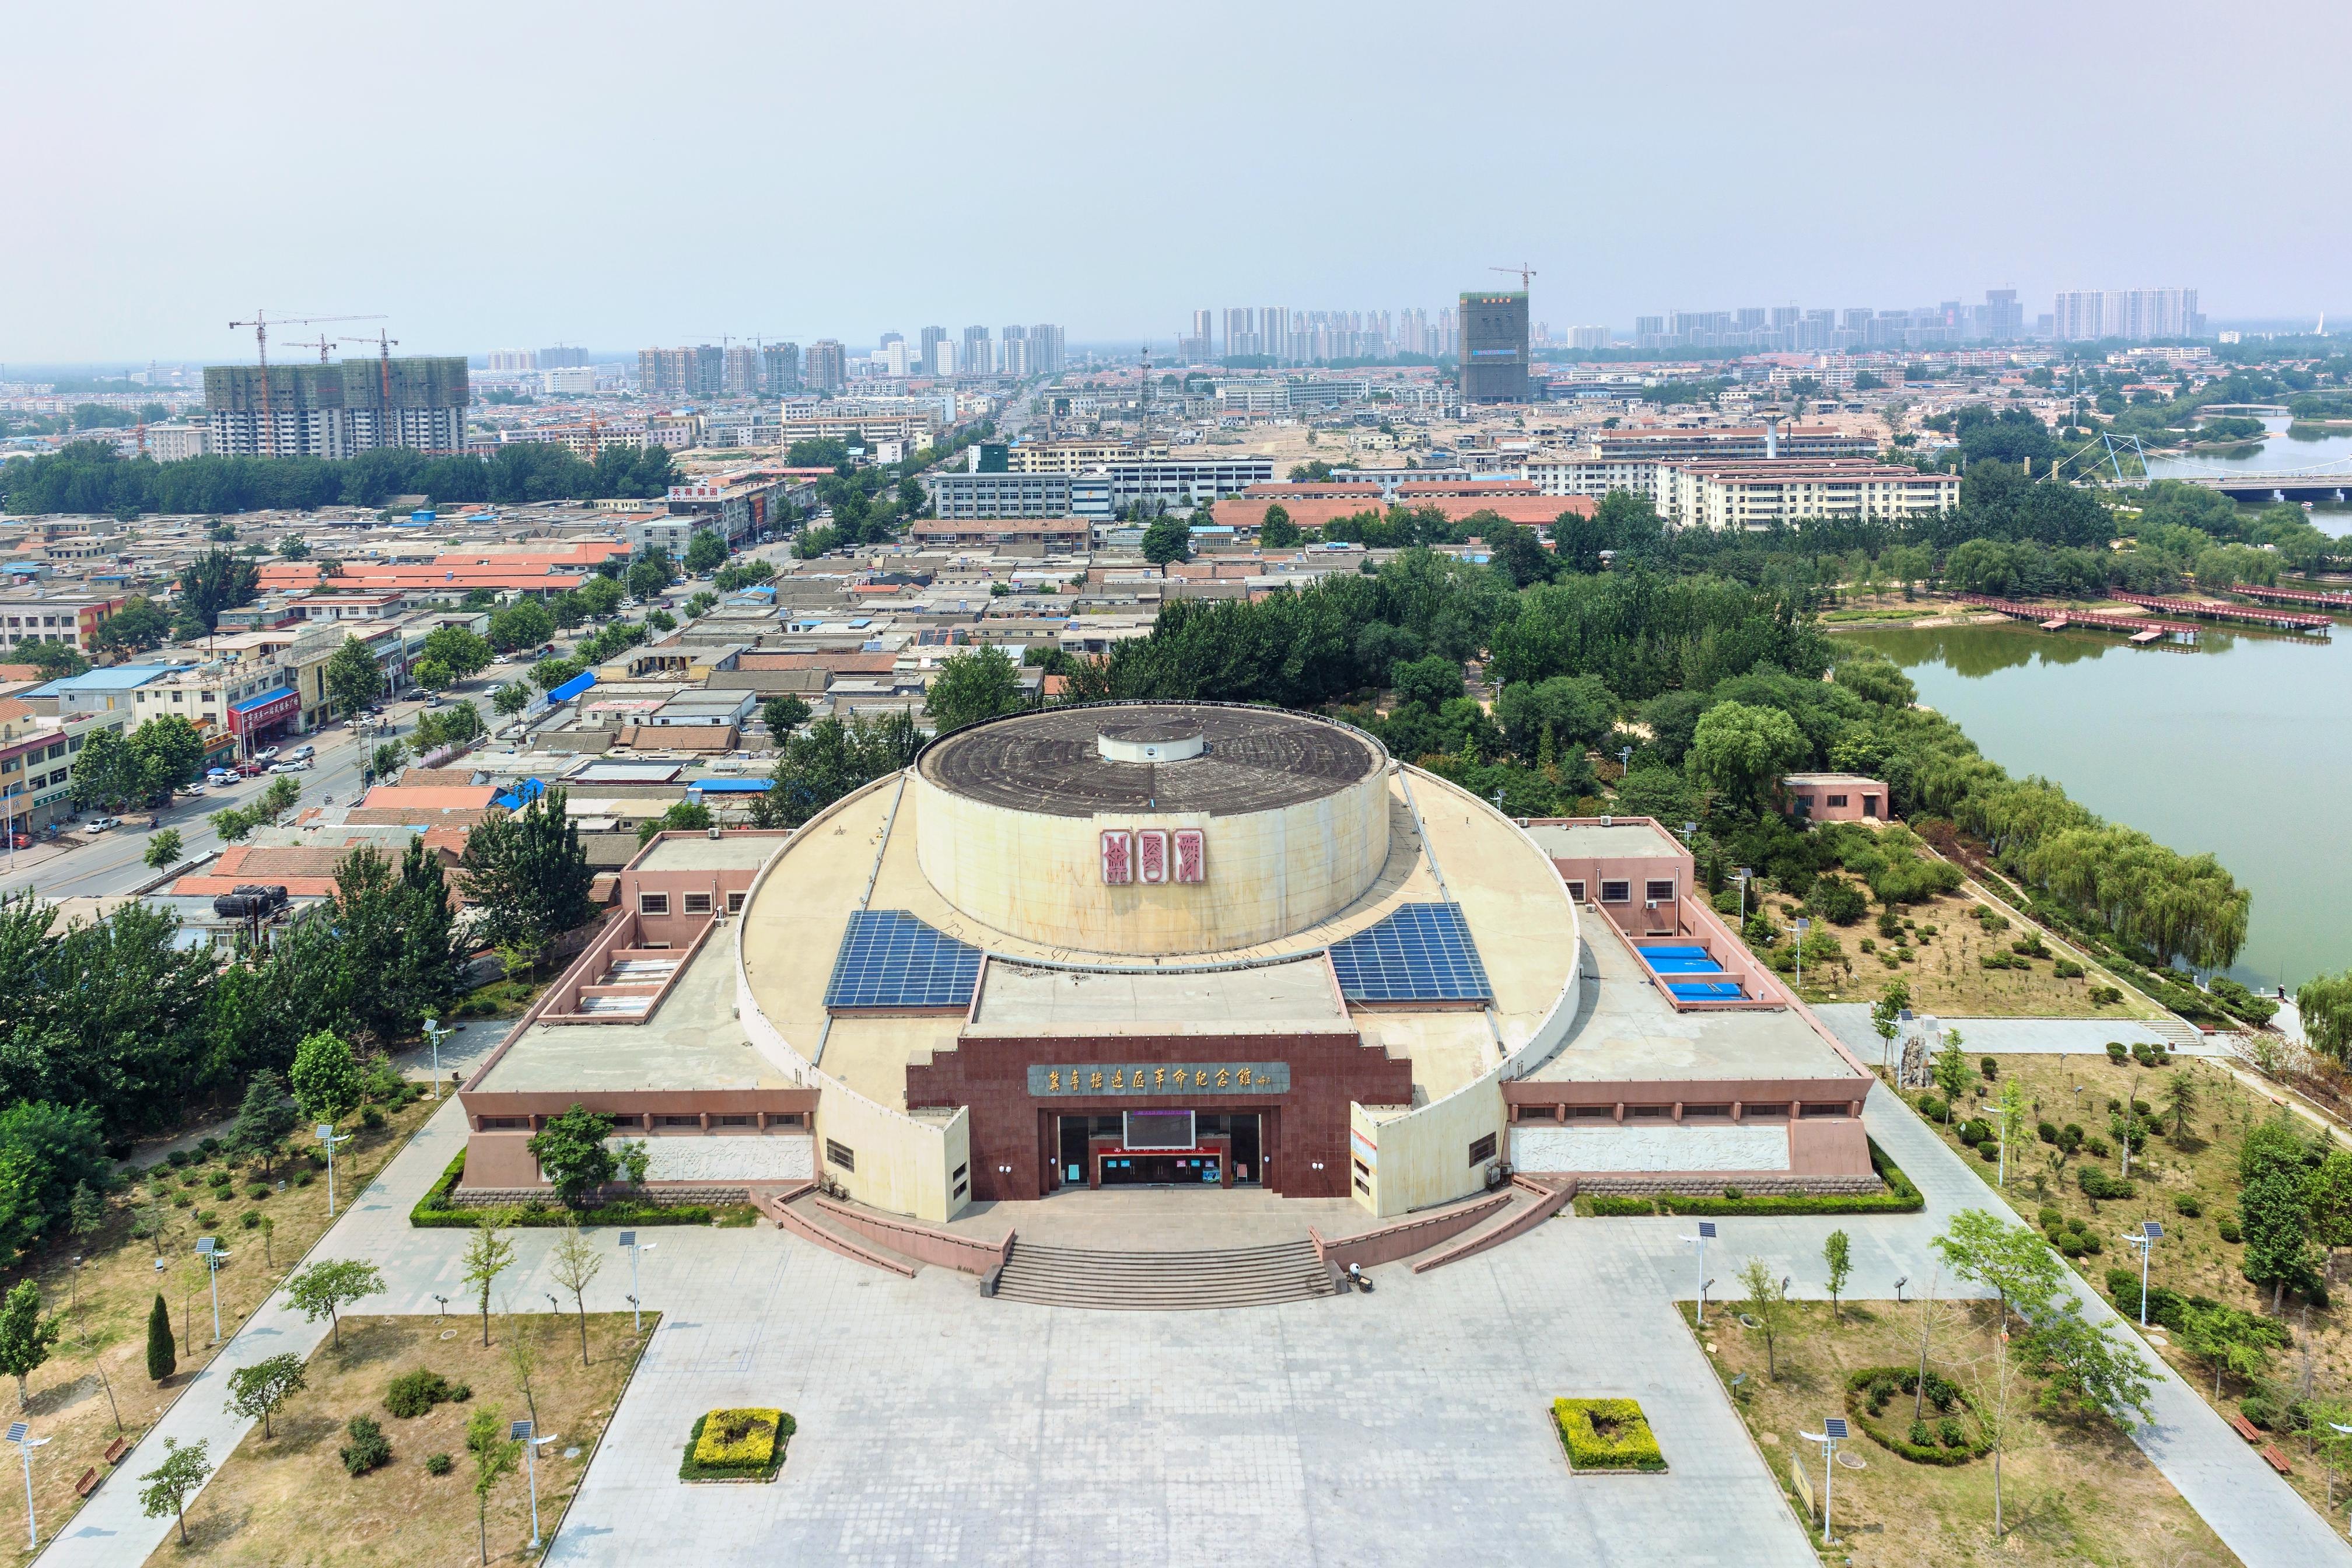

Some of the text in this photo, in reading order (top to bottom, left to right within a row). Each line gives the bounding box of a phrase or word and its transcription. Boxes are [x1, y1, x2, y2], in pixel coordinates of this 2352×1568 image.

[673, 488, 718, 496] 天荷御园
[0, 798, 22, 814] 会所
